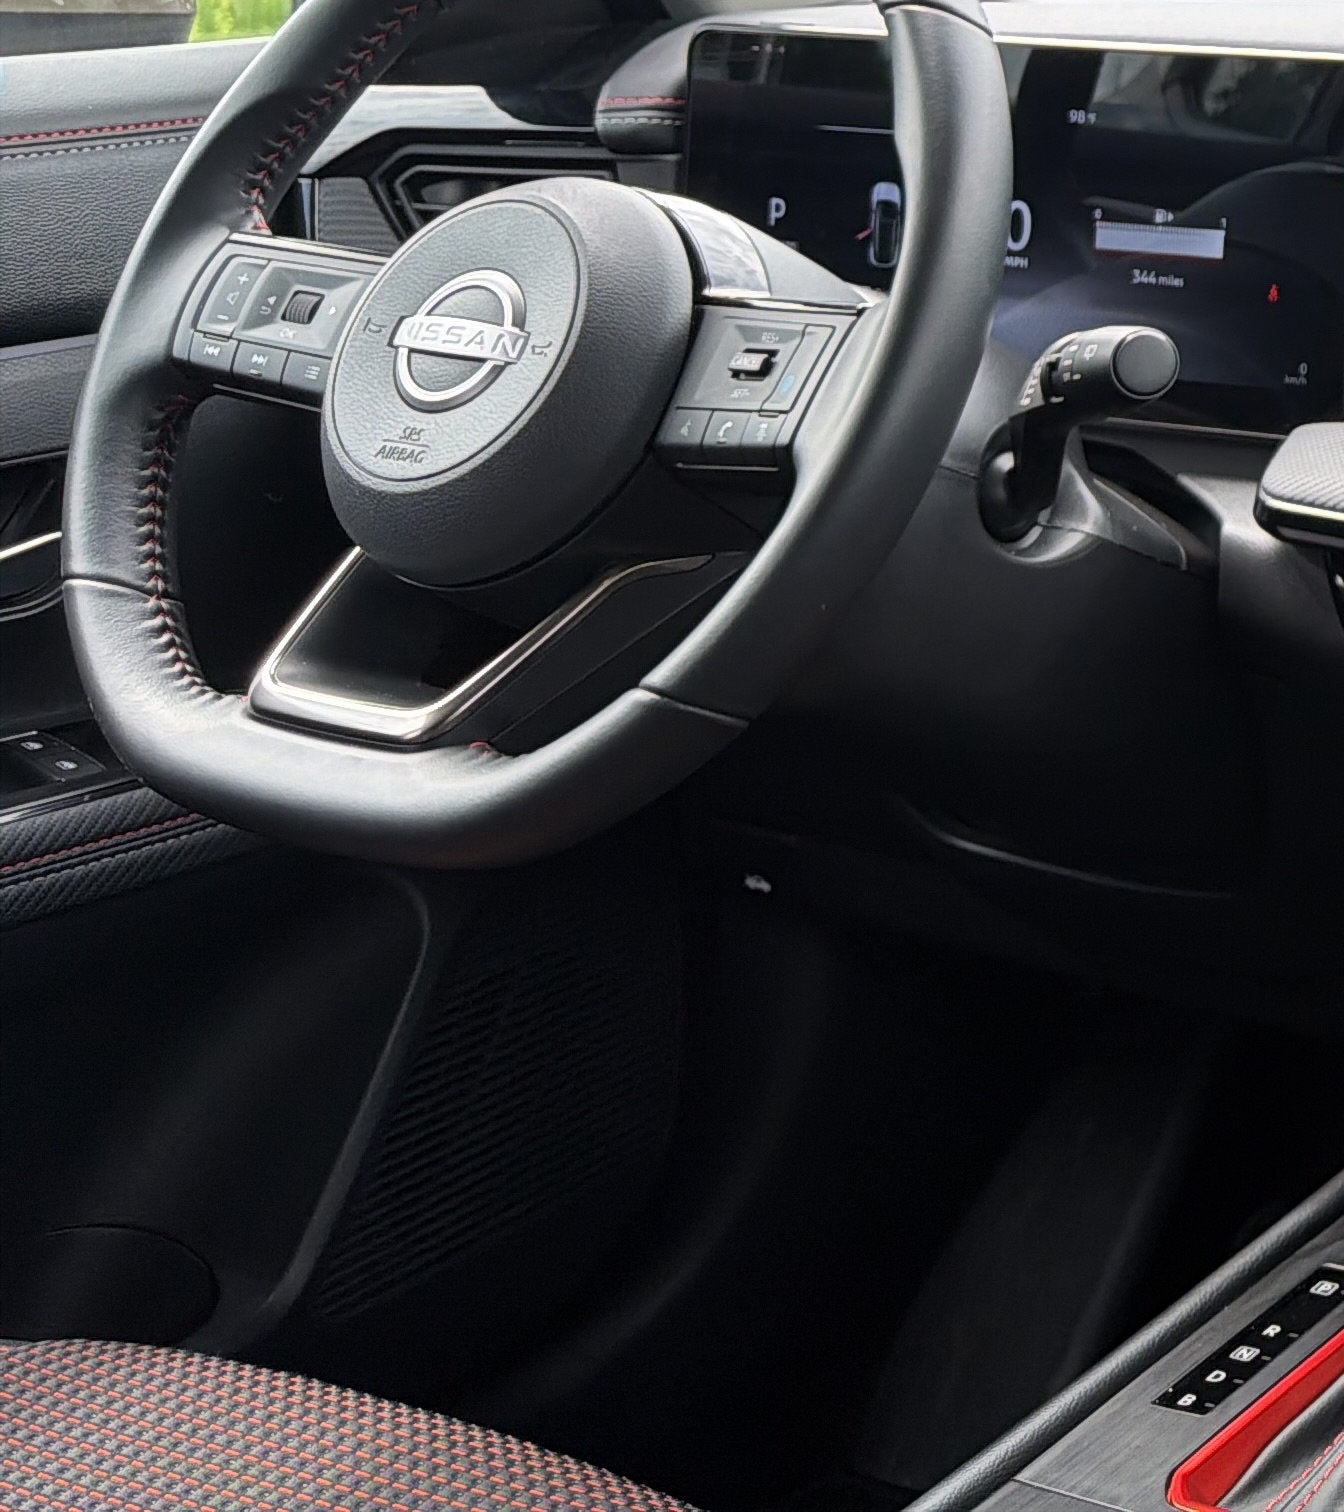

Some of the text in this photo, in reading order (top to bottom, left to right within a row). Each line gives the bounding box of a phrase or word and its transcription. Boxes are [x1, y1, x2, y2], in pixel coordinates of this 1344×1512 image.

[769, 197, 786, 226] P
[1131, 268, 1185, 288] 344 miles
[402, 320, 525, 360] NISSAN
[1299, 361, 1308, 375] 0
[399, 425, 425, 441] SRS
[373, 444, 427, 464] AIRBAG
[1261, 1324, 1281, 1337] R
[1204, 1370, 1226, 1382] D
[1177, 1393, 1197, 1406] B
